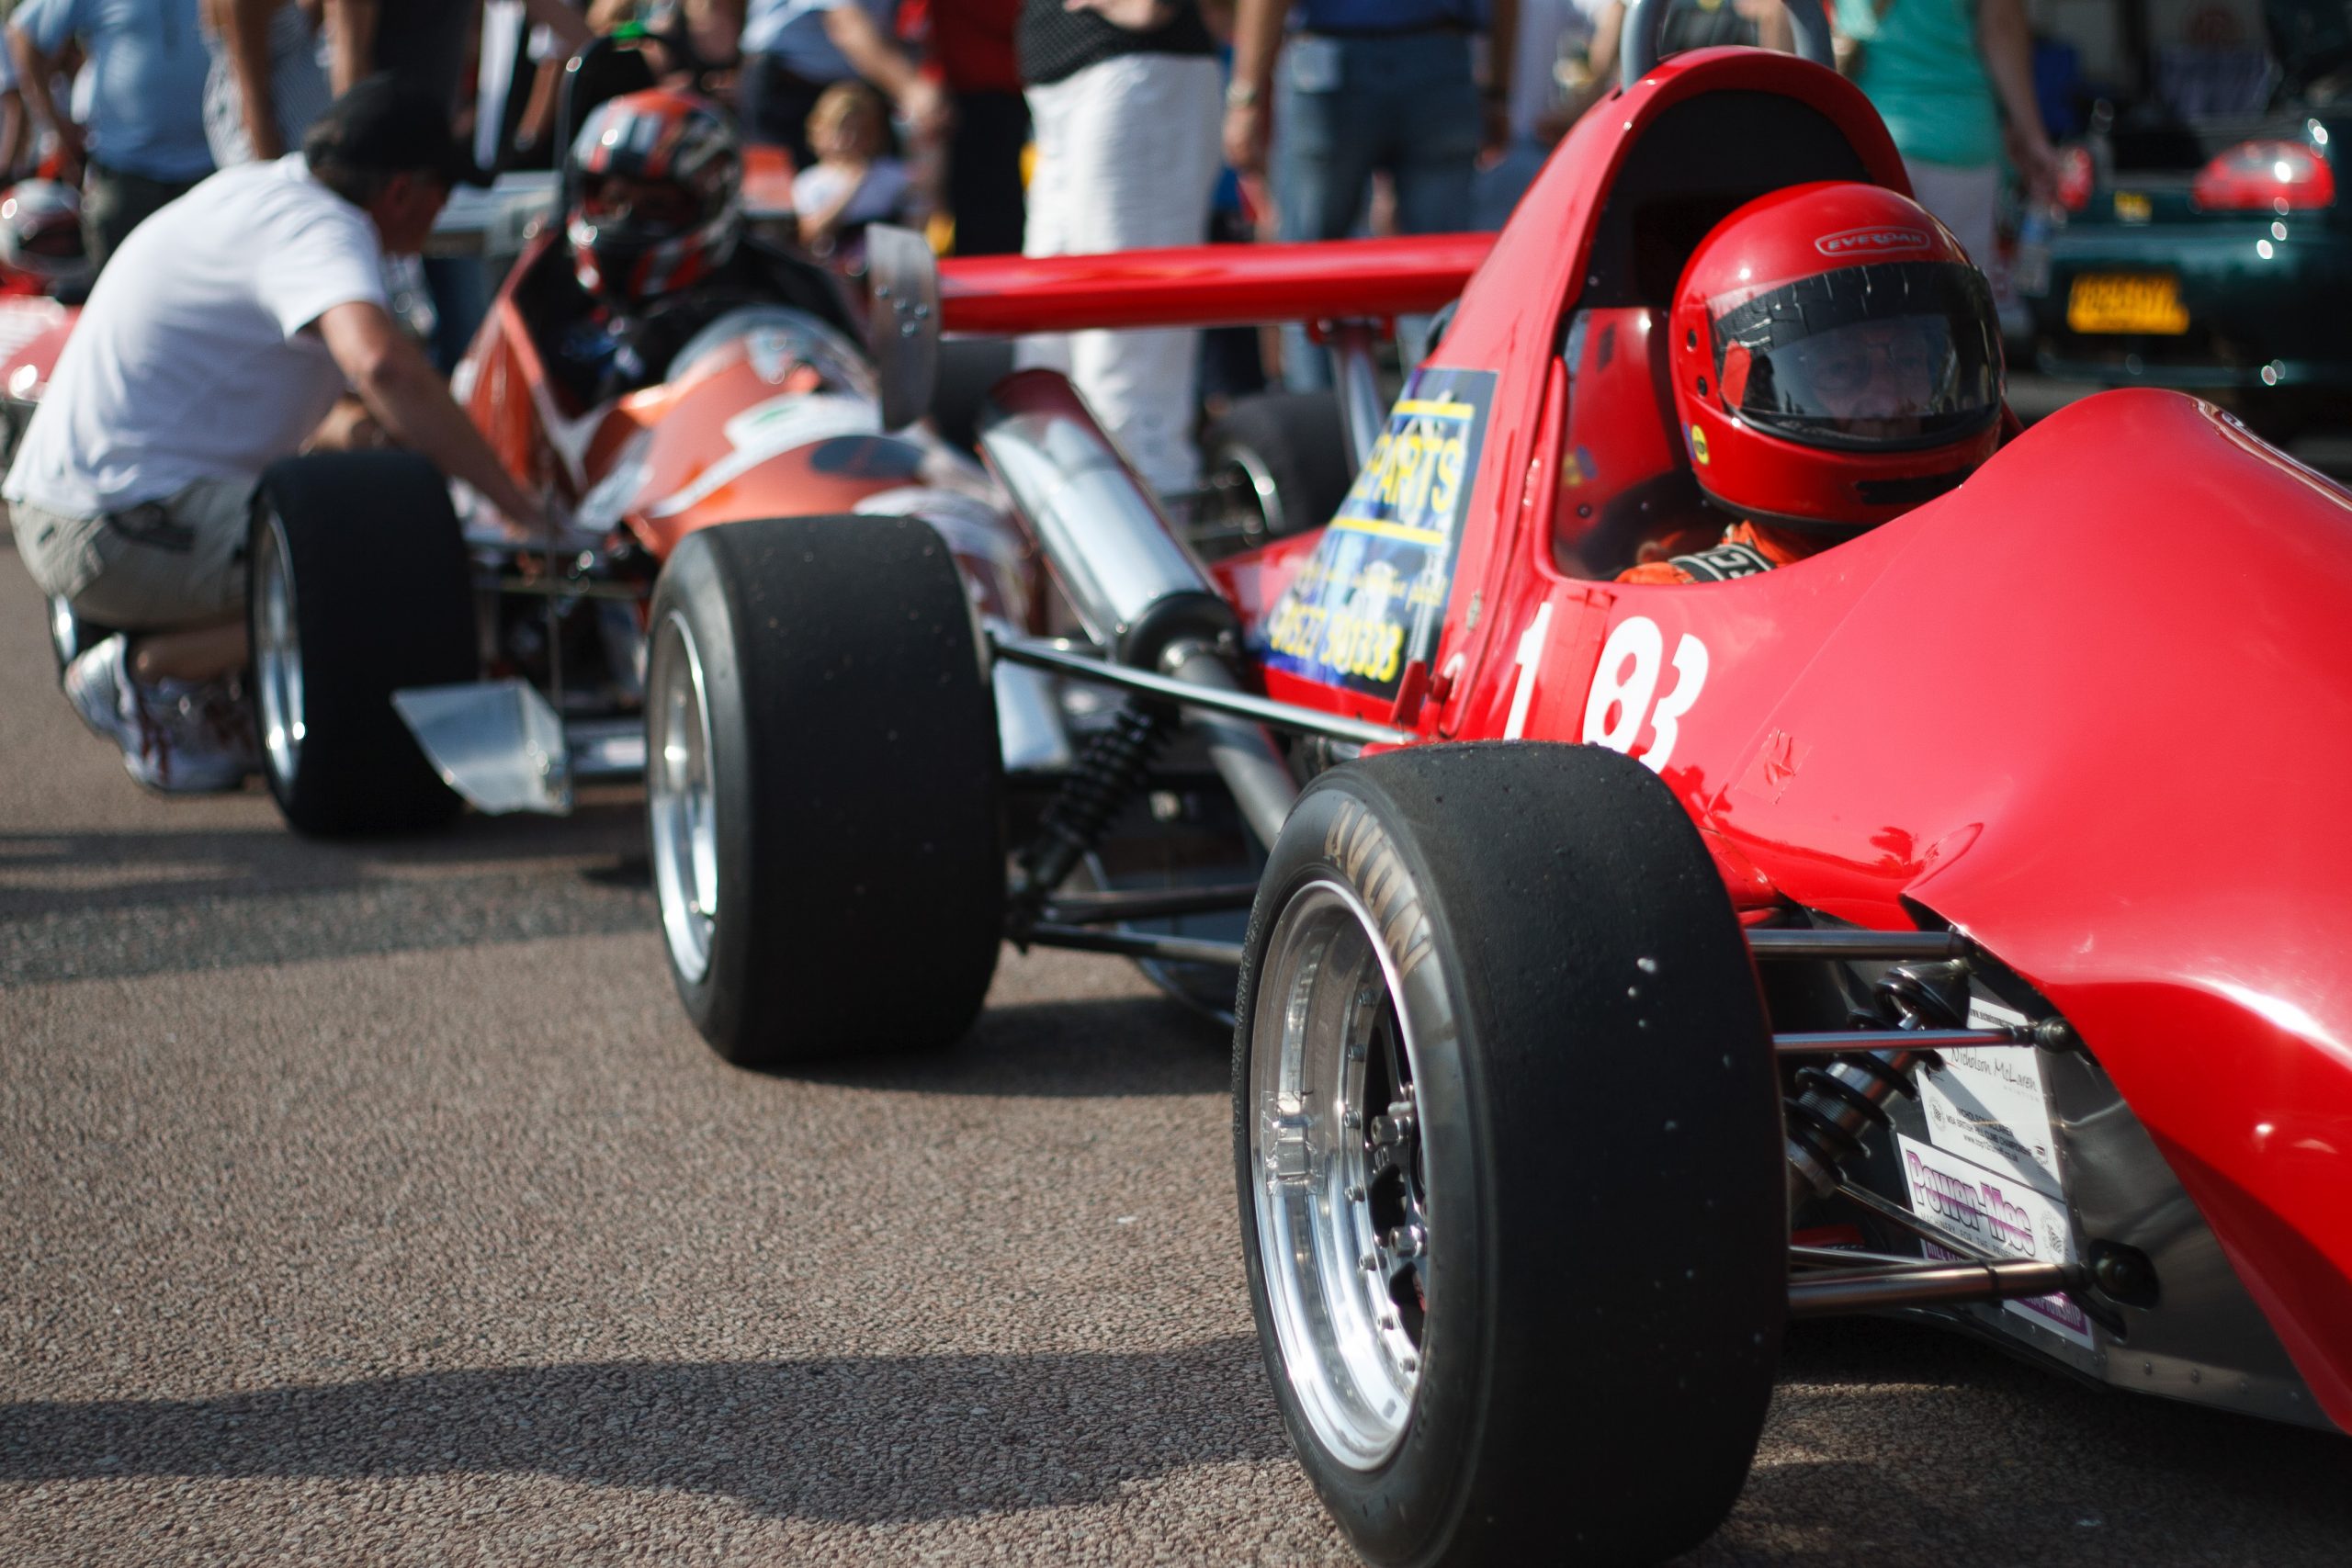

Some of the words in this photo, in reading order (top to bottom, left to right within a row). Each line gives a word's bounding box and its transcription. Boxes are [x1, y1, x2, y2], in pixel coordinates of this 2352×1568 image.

[1324, 799, 1433, 985] AVON
[1950, 1047, 1992, 1076] Nicholson
[1993, 1057, 2038, 1092] McLaren
